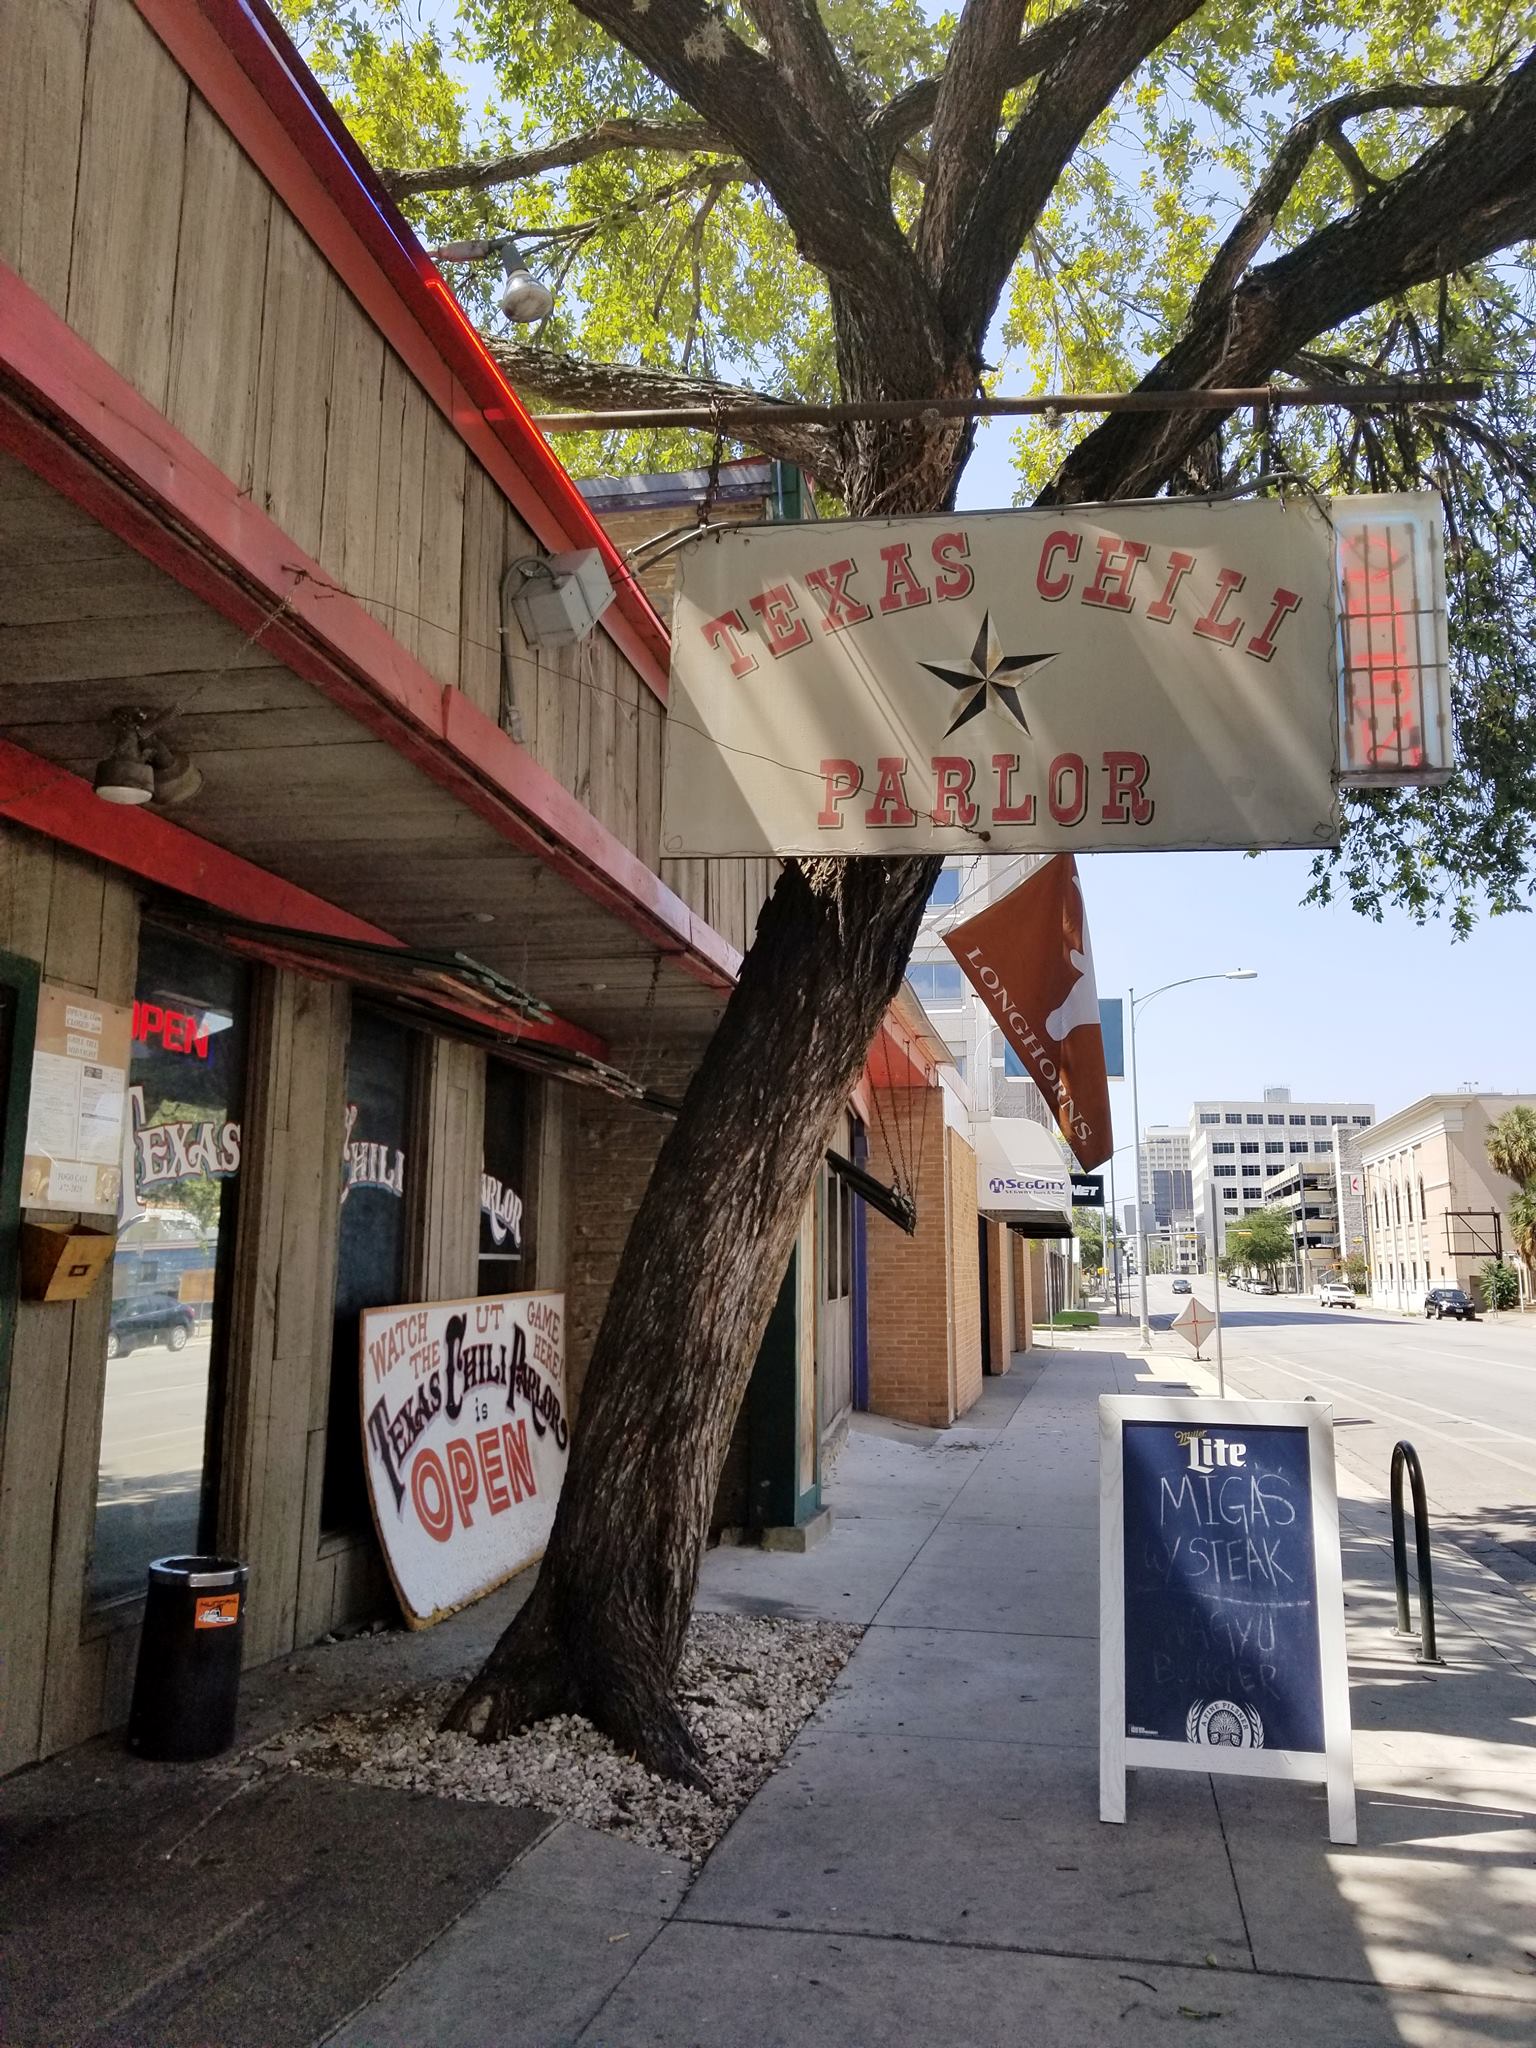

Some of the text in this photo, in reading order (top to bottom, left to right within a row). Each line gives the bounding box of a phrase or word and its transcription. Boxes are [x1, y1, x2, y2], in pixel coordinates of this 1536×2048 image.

[700, 529, 1302, 680] TEXAS CHILI
[817, 750, 1155, 829] PARLOR
[966, 946, 1093, 1140] LONGHORNS
[368, 1300, 561, 1384] WATCH UT GAME
[409, 1333, 565, 1387] THE HERE!
[367, 1313, 569, 1516] TEXAS CHILI PARLOR
[475, 1398, 488, 1422] is
[1174, 1430, 1208, 1446] Miller
[411, 1418, 537, 1543] OPEN
[1187, 1437, 1247, 1474] Lite
[1160, 1473, 1296, 1530] MIGAS
[1187, 1536, 1294, 1587] STEAK
[1204, 1703, 1220, 1719] FINE
[1222, 1702, 1249, 1730] PILSNER
